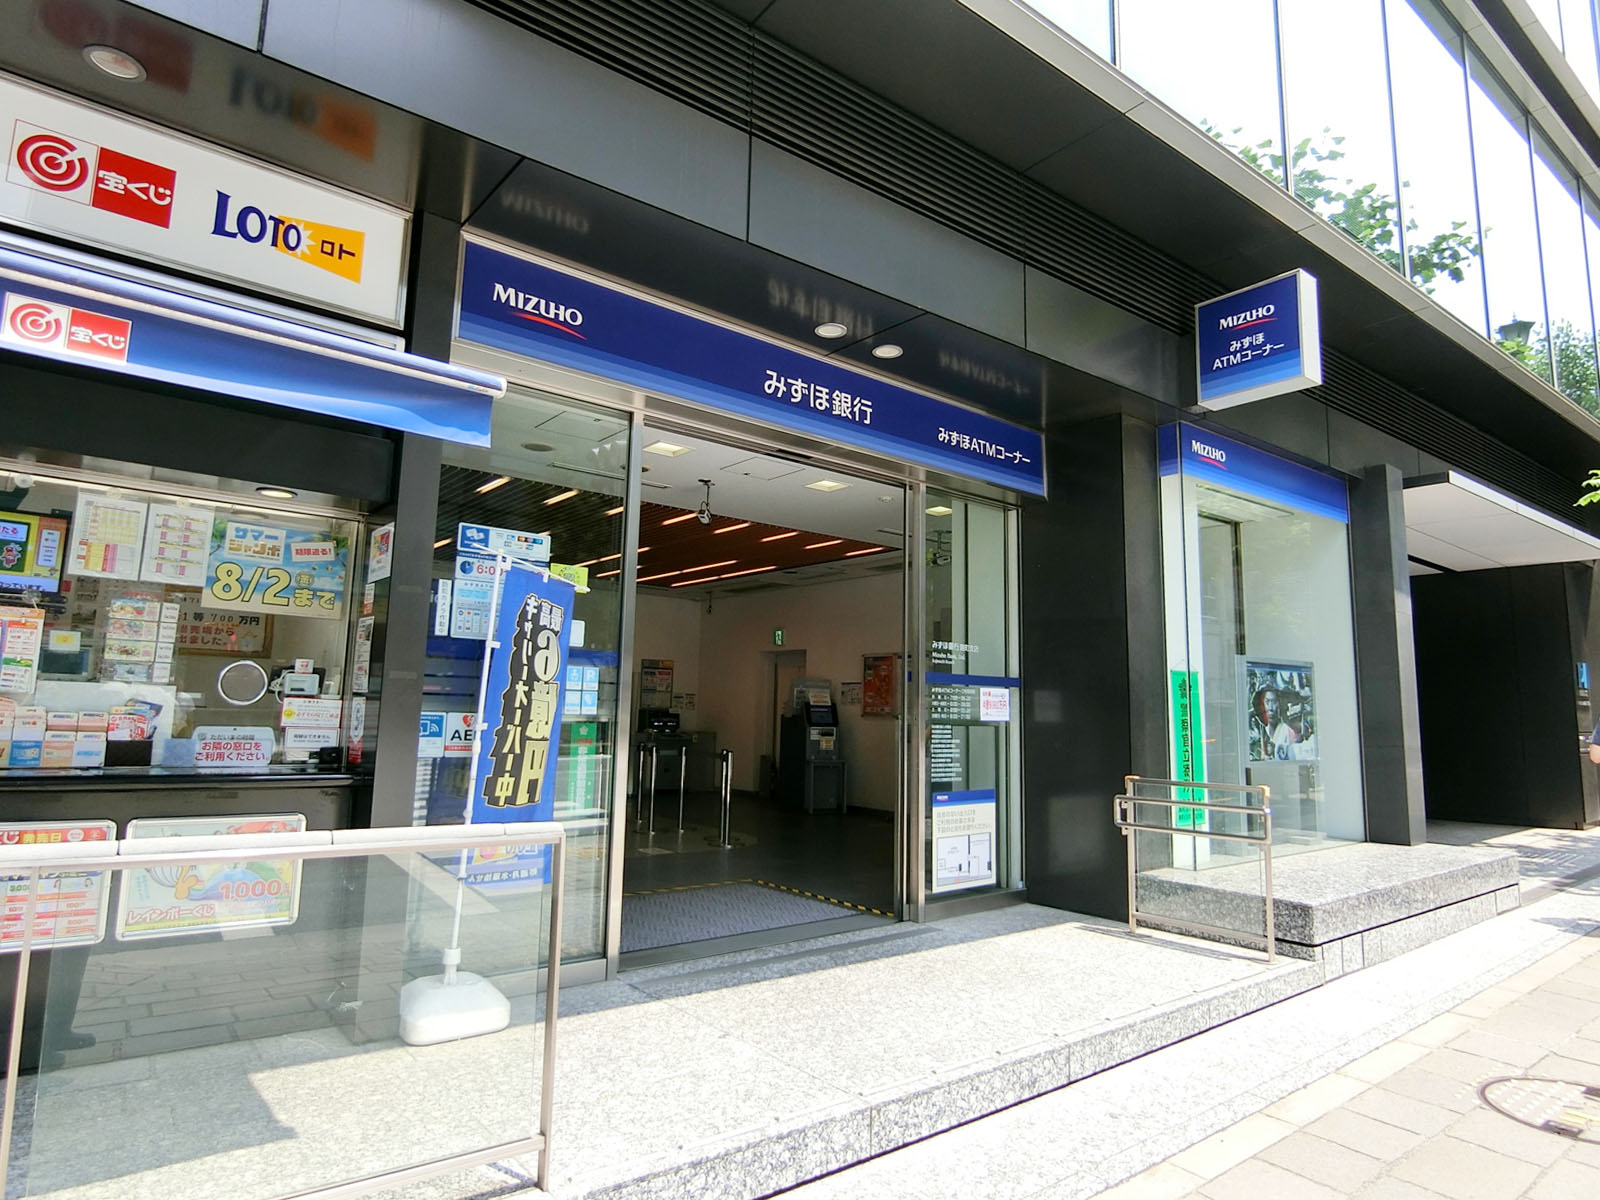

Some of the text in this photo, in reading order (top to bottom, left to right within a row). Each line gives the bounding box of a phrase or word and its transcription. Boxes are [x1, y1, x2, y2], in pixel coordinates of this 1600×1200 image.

[97, 170, 172, 206] 宝くじ
[211, 190, 357, 260] LOTO ロト
[492, 281, 584, 328] MIZUHO
[1219, 303, 1276, 331] MIZUHO
[69, 326, 125, 350] 宝くじ
[1229, 332, 1266, 352] みずほ
[1212, 343, 1285, 371] ATMコーナー
[763, 369, 873, 425] みずほ銀行
[937, 426, 1032, 465] みずほATMコーナー
[1191, 440, 1227, 463] MIZUHO
[234, 526, 280, 541] サマー
[227, 538, 281, 558] ジャンボ
[210, 561, 292, 607] 8/2
[293, 589, 337, 611] まで
[201, 741, 262, 751] お隣の窓口を
[450, 728, 477, 741] AE
[195, 751, 267, 761] ご利用ください。
[128, 904, 216, 925] レインボーくじ
